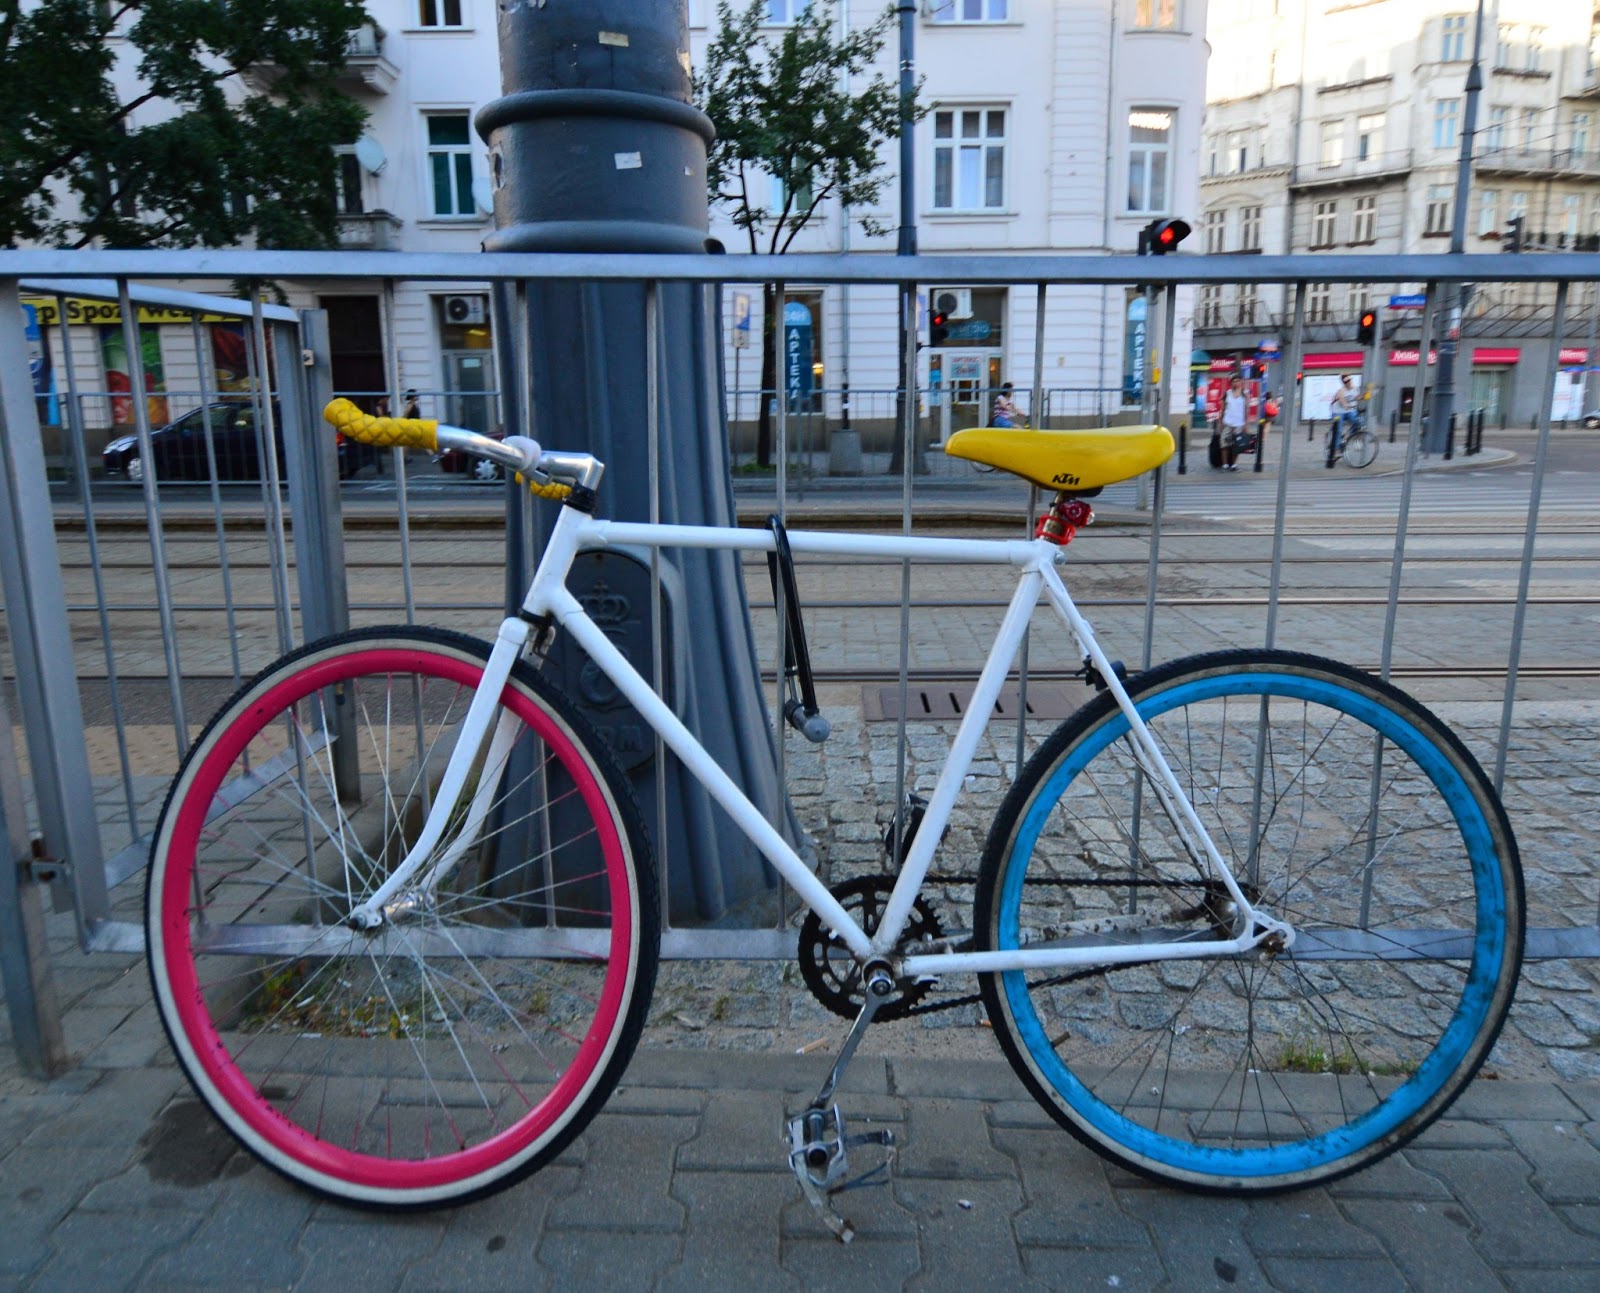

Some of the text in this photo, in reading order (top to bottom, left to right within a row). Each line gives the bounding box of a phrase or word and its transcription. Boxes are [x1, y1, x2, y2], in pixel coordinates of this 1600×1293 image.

[788, 328, 801, 400] APTEKA
[1133, 322, 1146, 393] APTEKA
[1052, 473, 1080, 486] KTM
